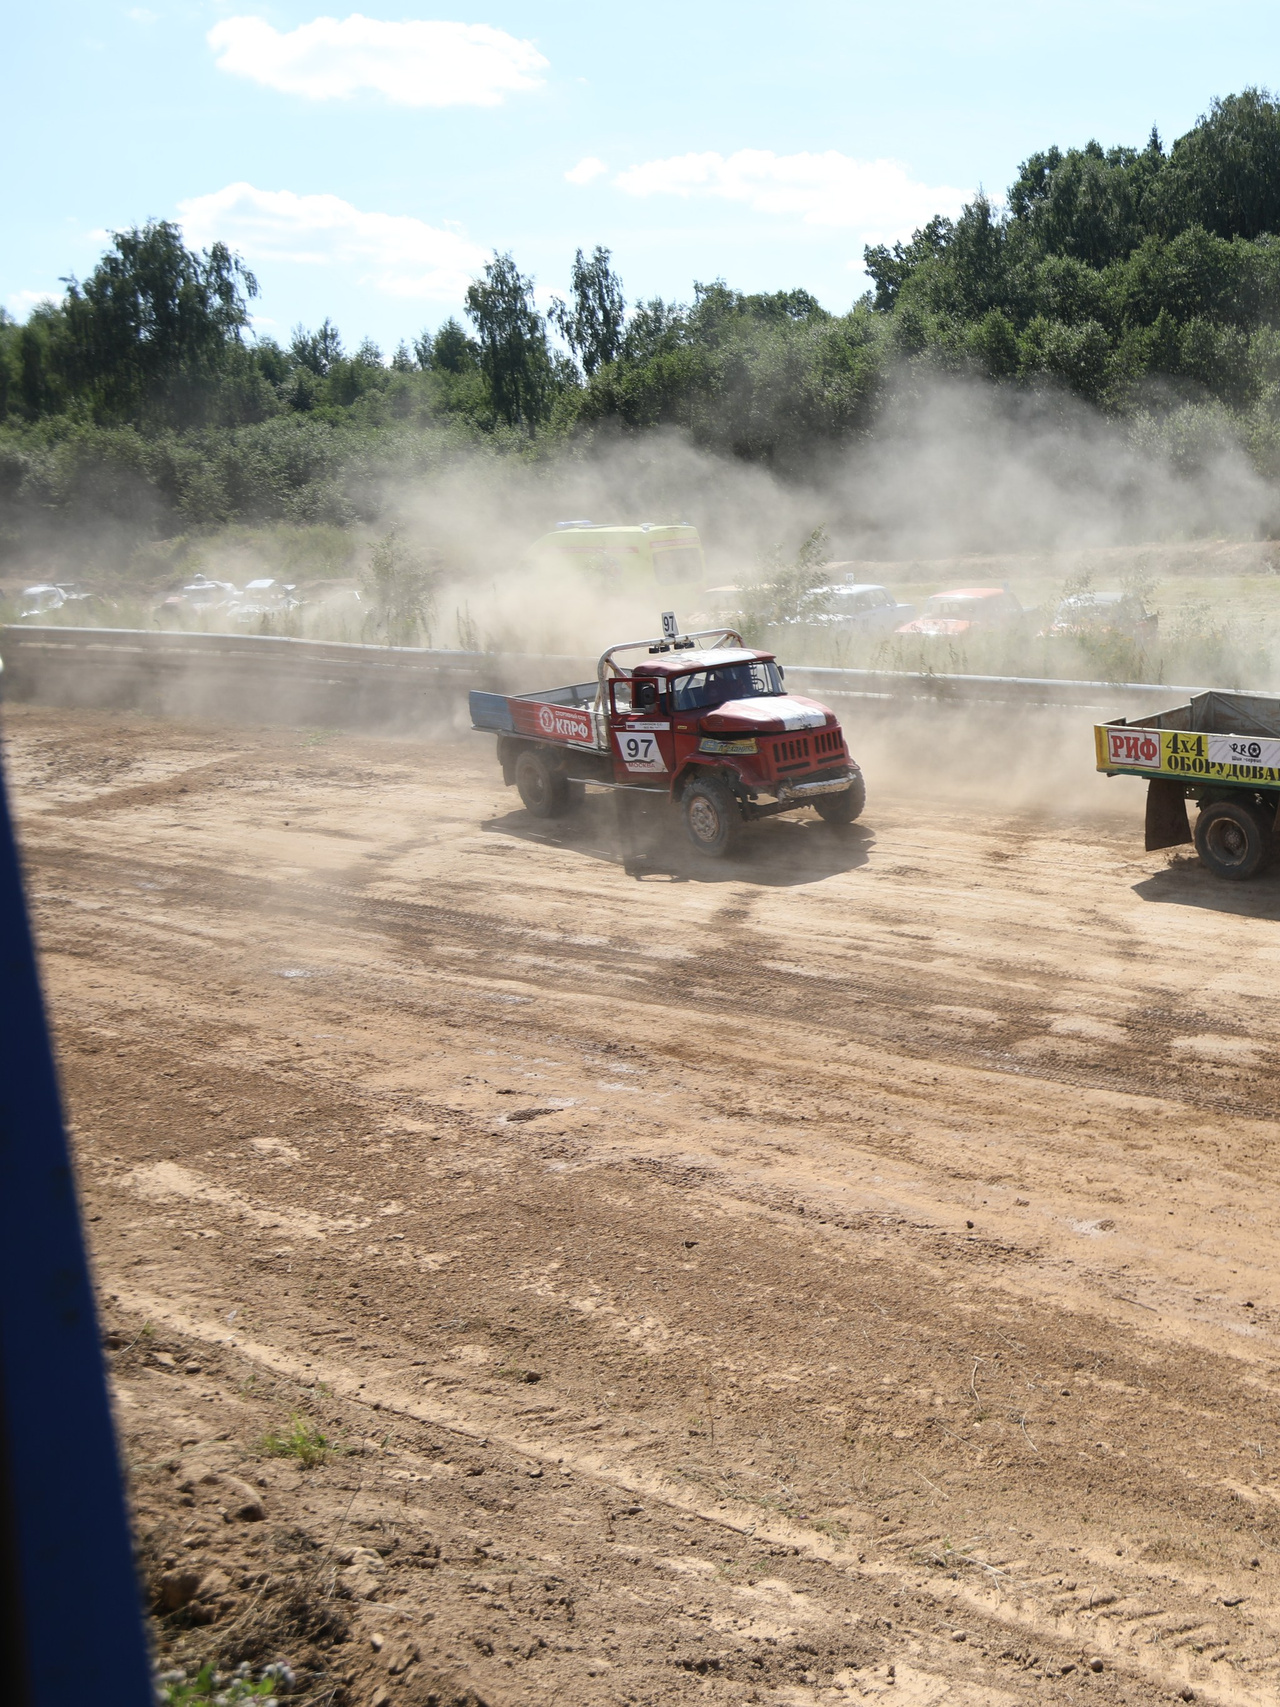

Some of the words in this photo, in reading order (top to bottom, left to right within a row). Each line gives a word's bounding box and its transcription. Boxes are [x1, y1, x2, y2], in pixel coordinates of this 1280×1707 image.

[663, 616, 674, 632] 97
[555, 717, 588, 739] КПРФ
[626, 738, 654, 758] 97
[1111, 735, 1157, 761] РИФ
